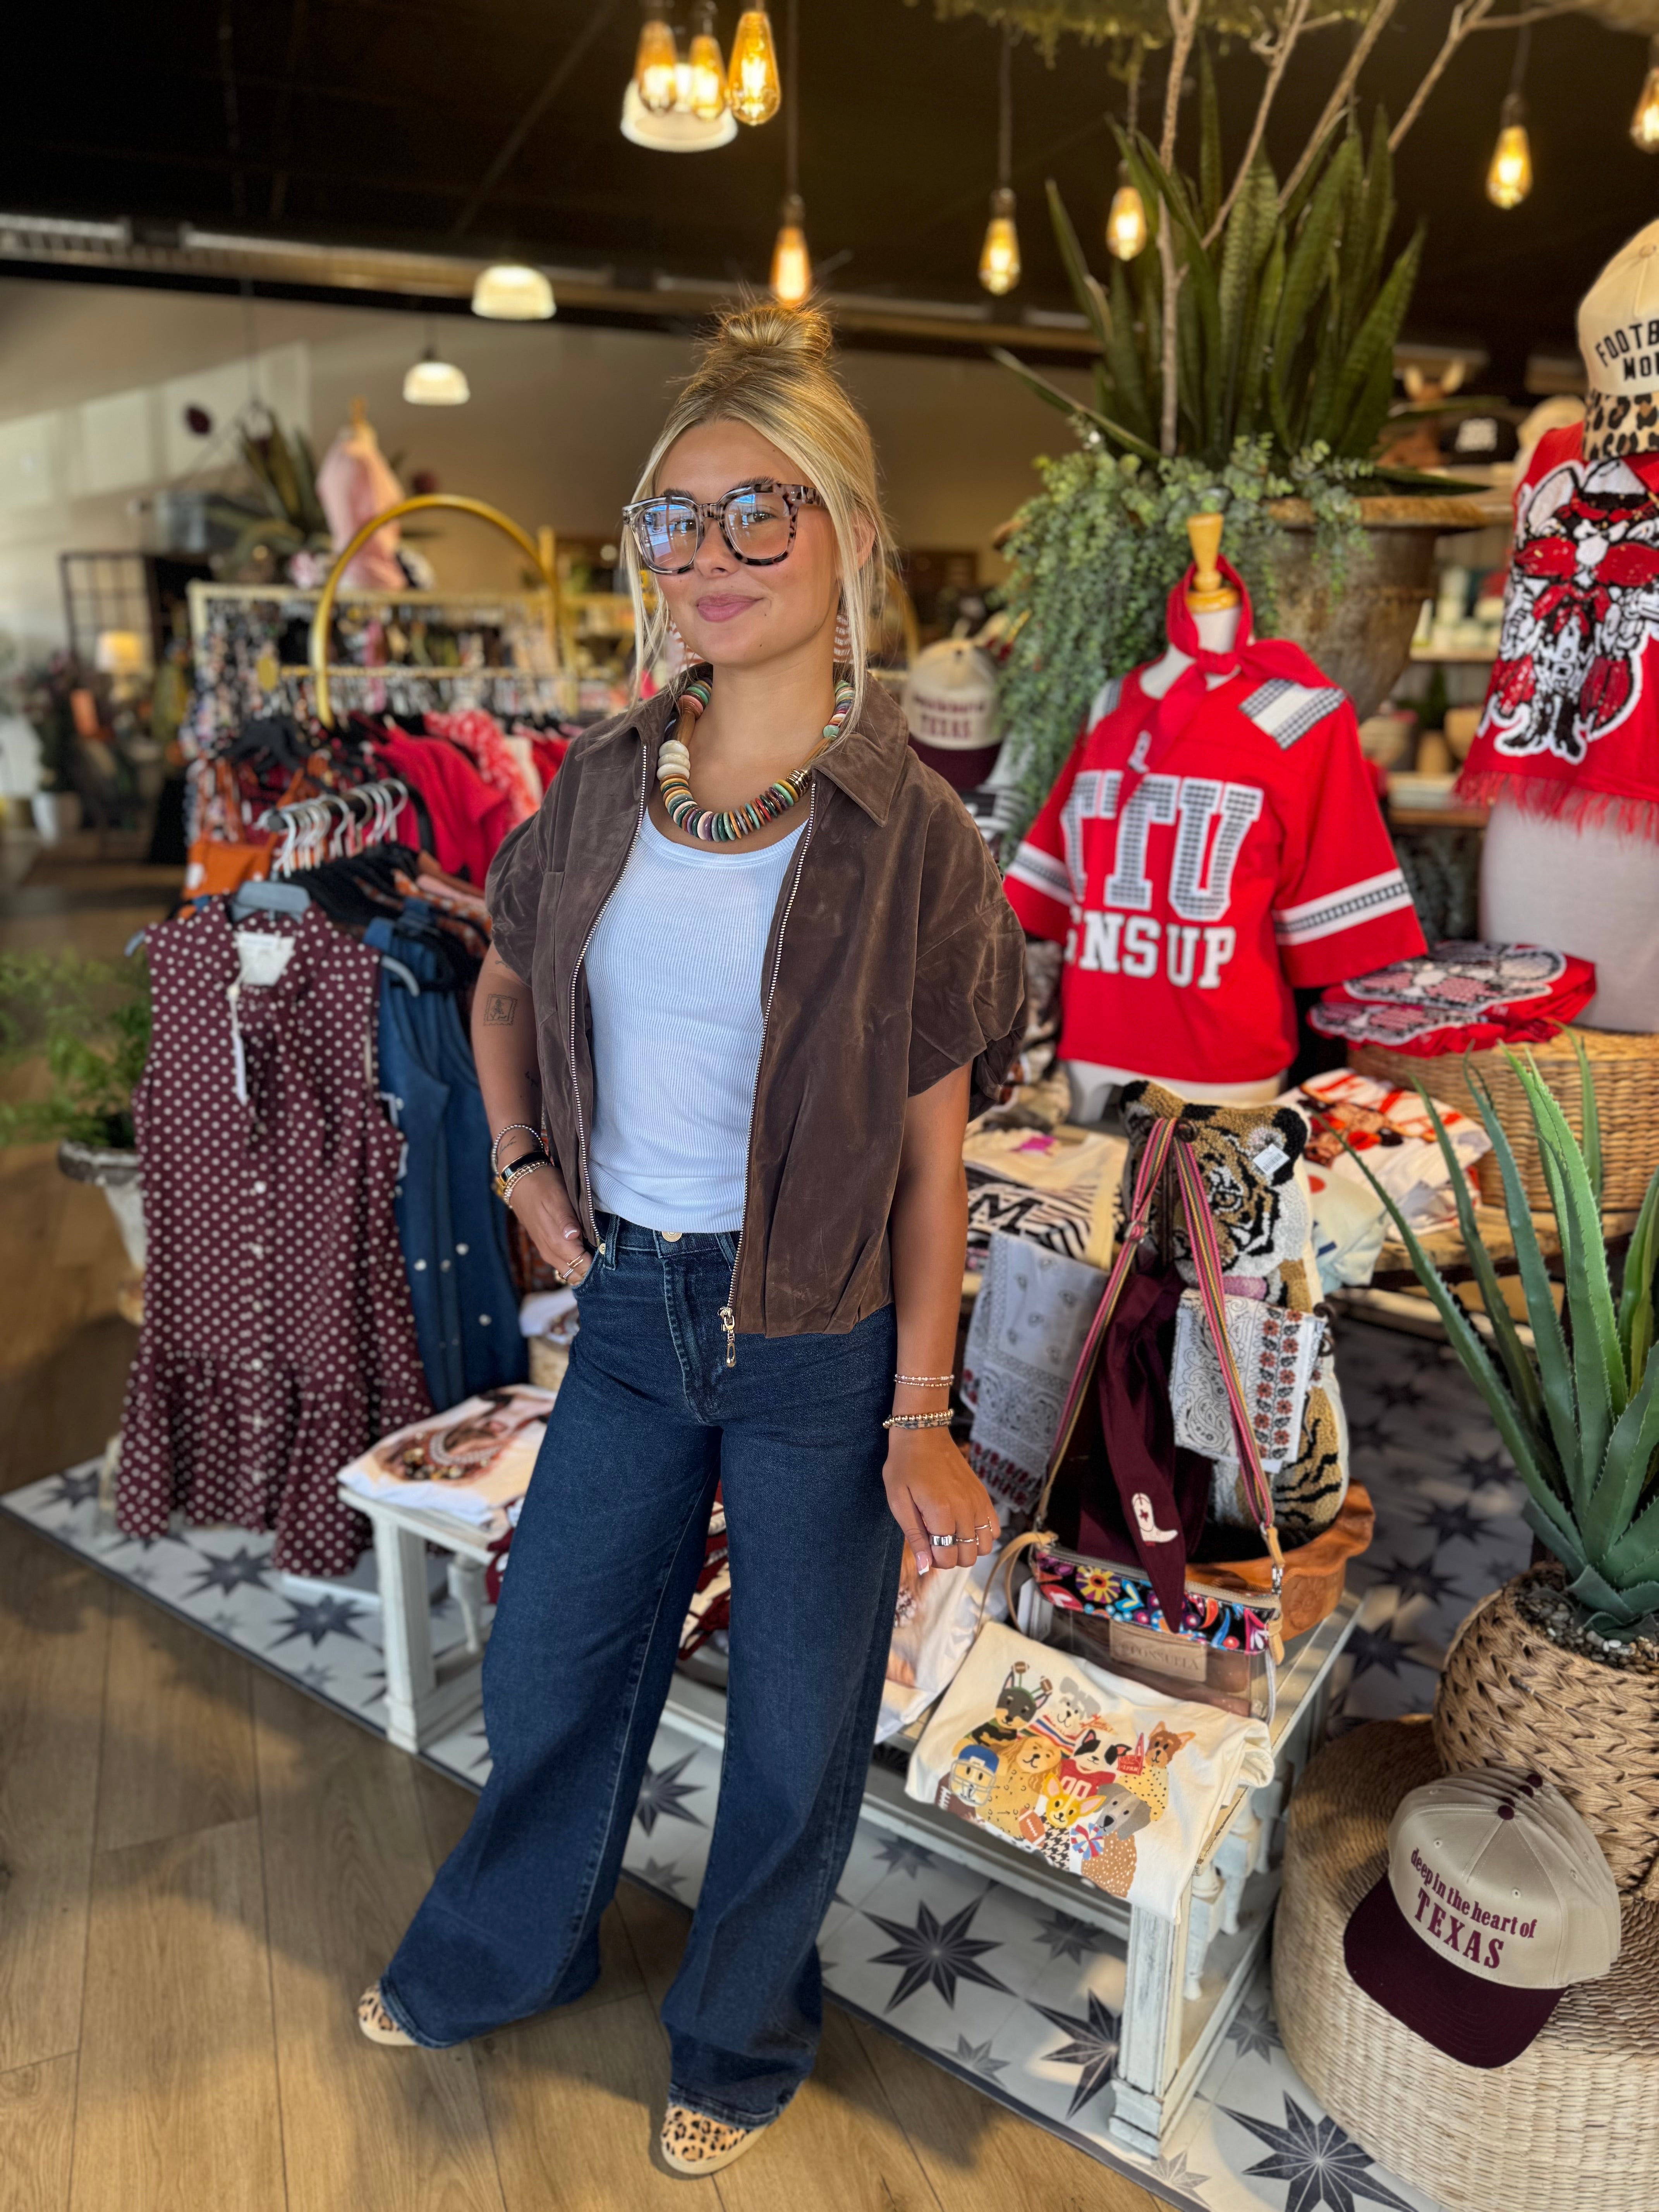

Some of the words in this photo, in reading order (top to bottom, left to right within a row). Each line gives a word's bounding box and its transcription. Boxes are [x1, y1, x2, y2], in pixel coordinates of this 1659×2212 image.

[1595, 319, 1659, 367] FOOTB
[1059, 769, 1264, 921] TTU
[1064, 904, 1161, 979] NS
[1165, 923, 1236, 989] UP
[1411, 1847, 1433, 1886] deep
[1432, 1873, 1446, 1899] in
[1446, 1887, 1471, 1915] the
[1470, 1901, 1518, 1935] heart
[1520, 1919, 1538, 1939] of
[1414, 1887, 1504, 1969] TEXAS
